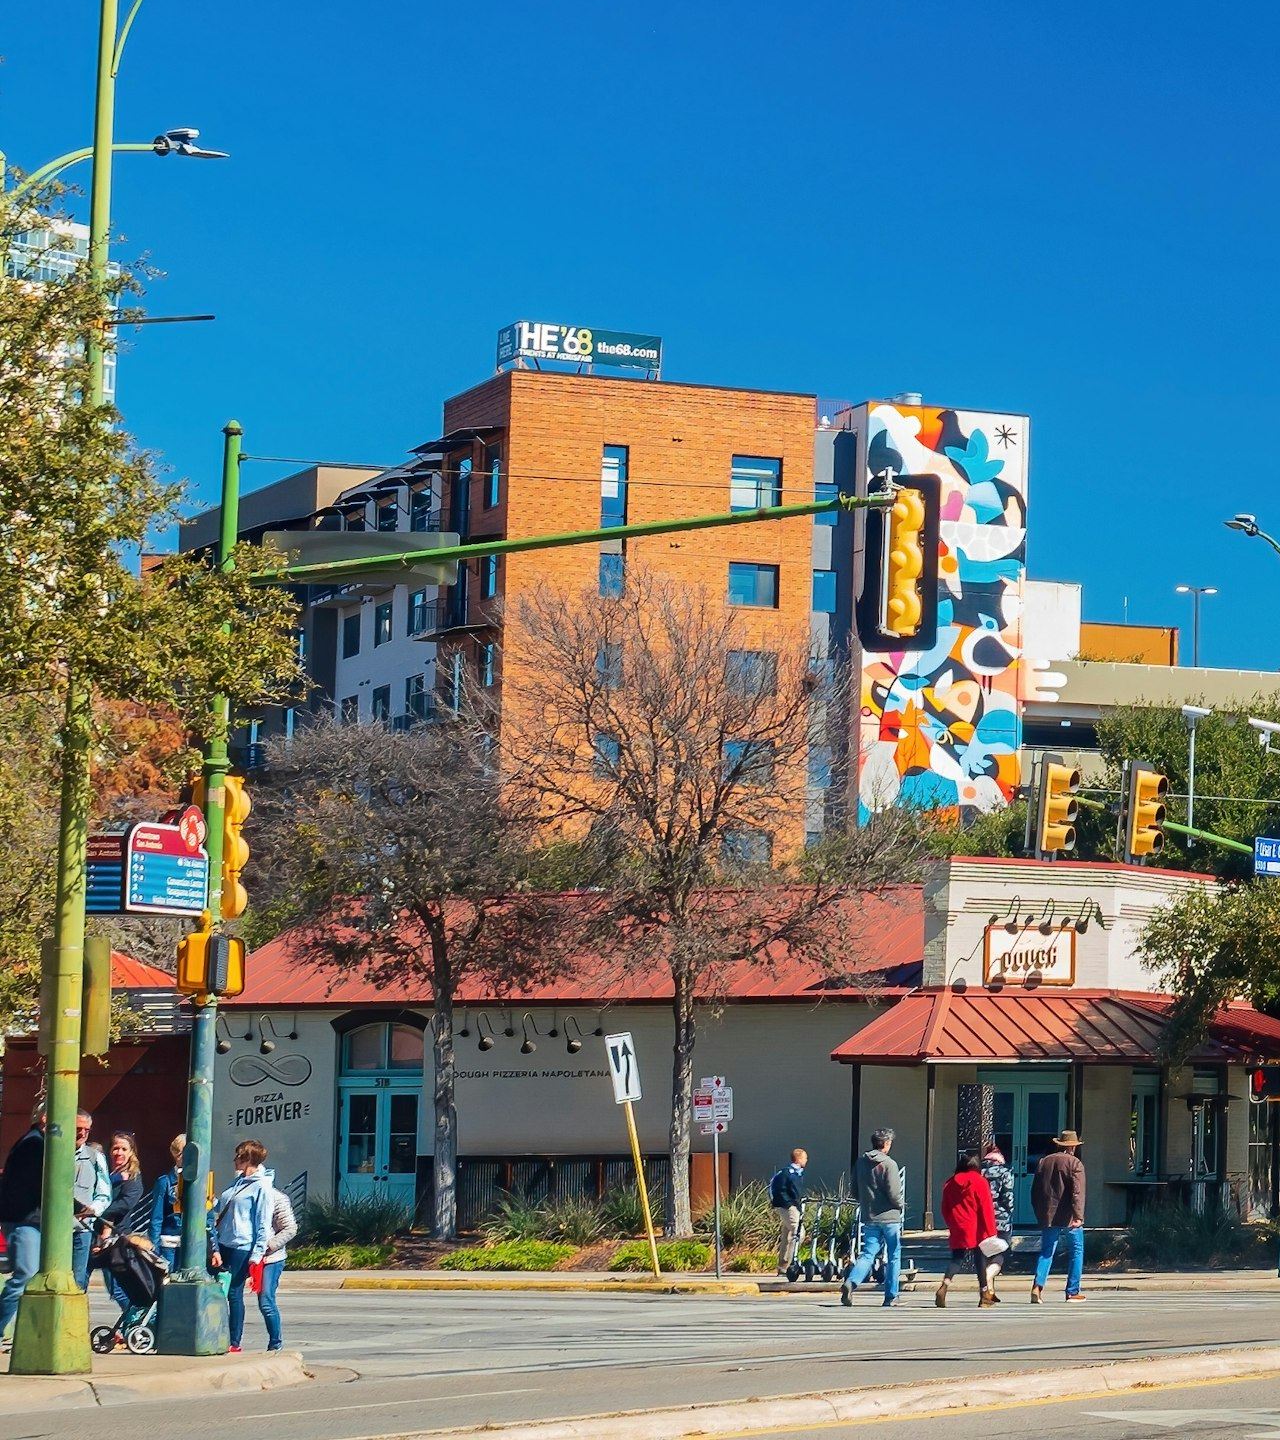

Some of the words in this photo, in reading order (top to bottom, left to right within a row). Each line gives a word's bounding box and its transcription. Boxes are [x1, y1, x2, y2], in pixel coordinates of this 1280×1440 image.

[597, 341, 657, 359] the68.com
[1000, 946, 1057, 973] DOUGH
[453, 1070, 489, 1079] DOUGH
[493, 1070, 538, 1079] PIZZERIA
[542, 1070, 611, 1078] NAPOLETANA
[253, 1092, 284, 1104] PIZZA
[235, 1101, 302, 1127] FOREVER
